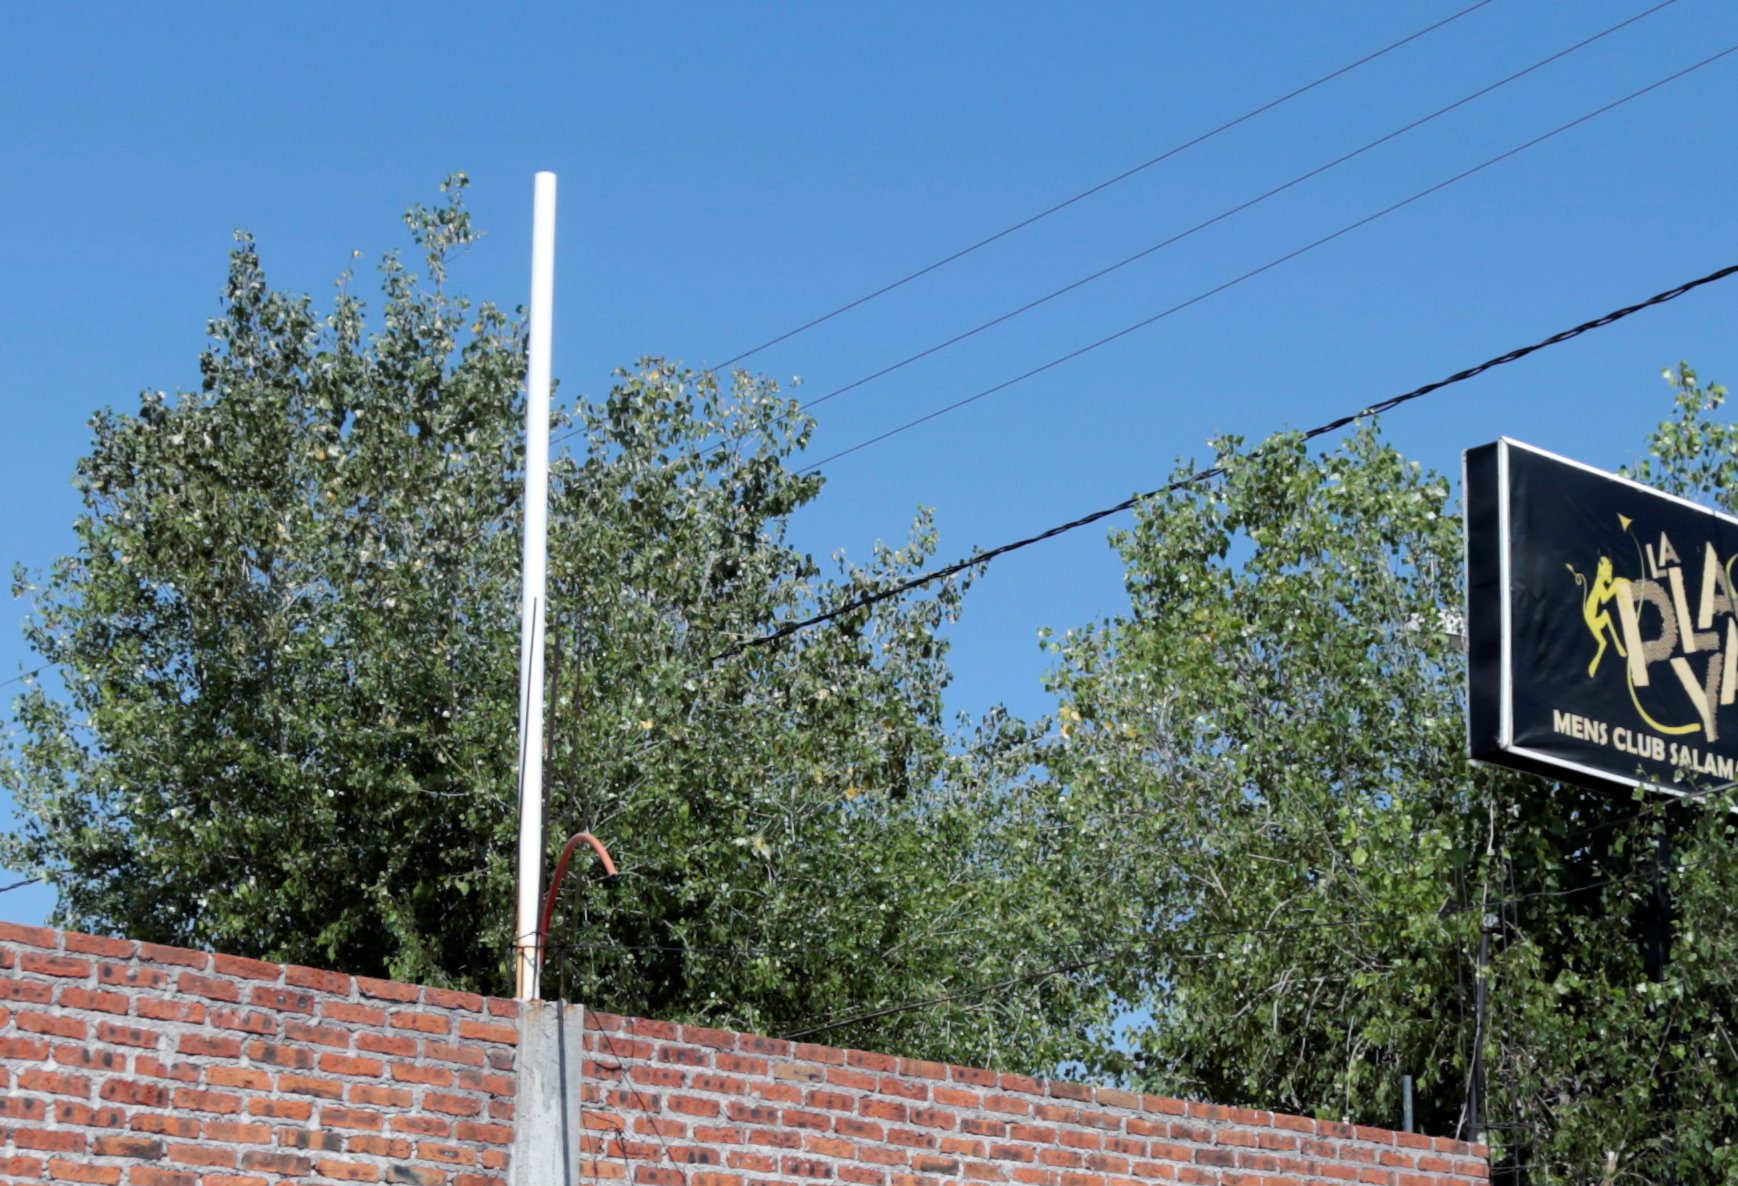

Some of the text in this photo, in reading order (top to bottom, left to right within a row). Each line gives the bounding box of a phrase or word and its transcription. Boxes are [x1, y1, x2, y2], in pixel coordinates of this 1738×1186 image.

[1646, 530, 1681, 578] LA
[1553, 709, 1608, 746] MENS
[1612, 726, 1665, 761] CLUB
